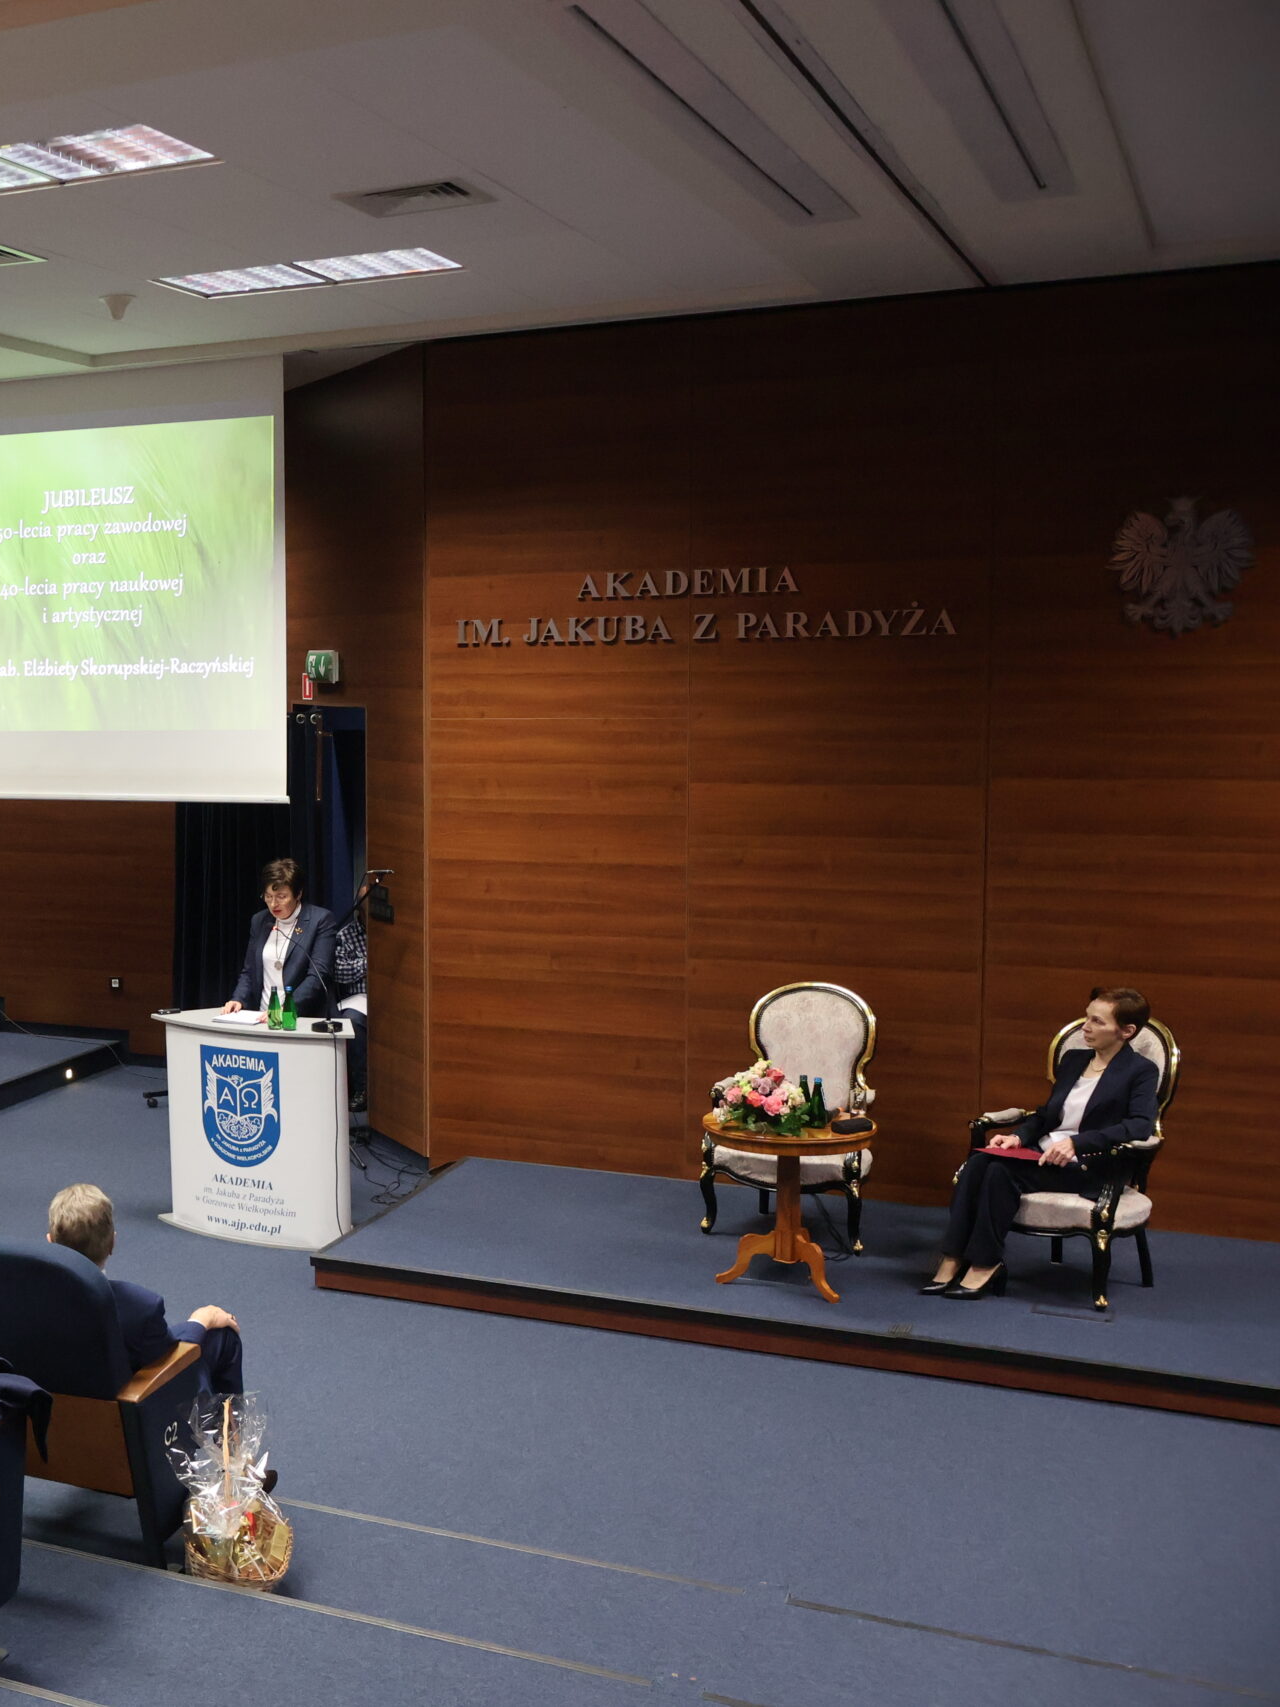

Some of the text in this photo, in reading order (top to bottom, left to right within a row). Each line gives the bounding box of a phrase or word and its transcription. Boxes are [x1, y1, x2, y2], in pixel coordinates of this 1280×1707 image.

[41, 486, 134, 514] JUBILEUSZ
[57, 522, 99, 543] pracy
[104, 512, 187, 538] zawodowej
[72, 552, 106, 565] oraz
[0, 572, 184, 601] 40-lecia pracy naukowej
[577, 566, 800, 600] AKADEMIA
[42, 604, 143, 629] i artystycznej
[456, 601, 958, 646] IM. JAKUBA Z PARADYŻA
[23, 657, 78, 681] Elżbiety
[80, 653, 255, 681] Skorupskiej-Raczyńskiej
[211, 1054, 266, 1073] AKADEMIA
[212, 1173, 273, 1191] AKADEMIA
[216, 1187, 241, 1200] Jakuba
[202, 1195, 235, 1209] Gorzowie
[237, 1202, 297, 1218] Wielkopolskim
[207, 1214, 282, 1236] www.ajp.edu.pl
[164, 1421, 178, 1446] C2
